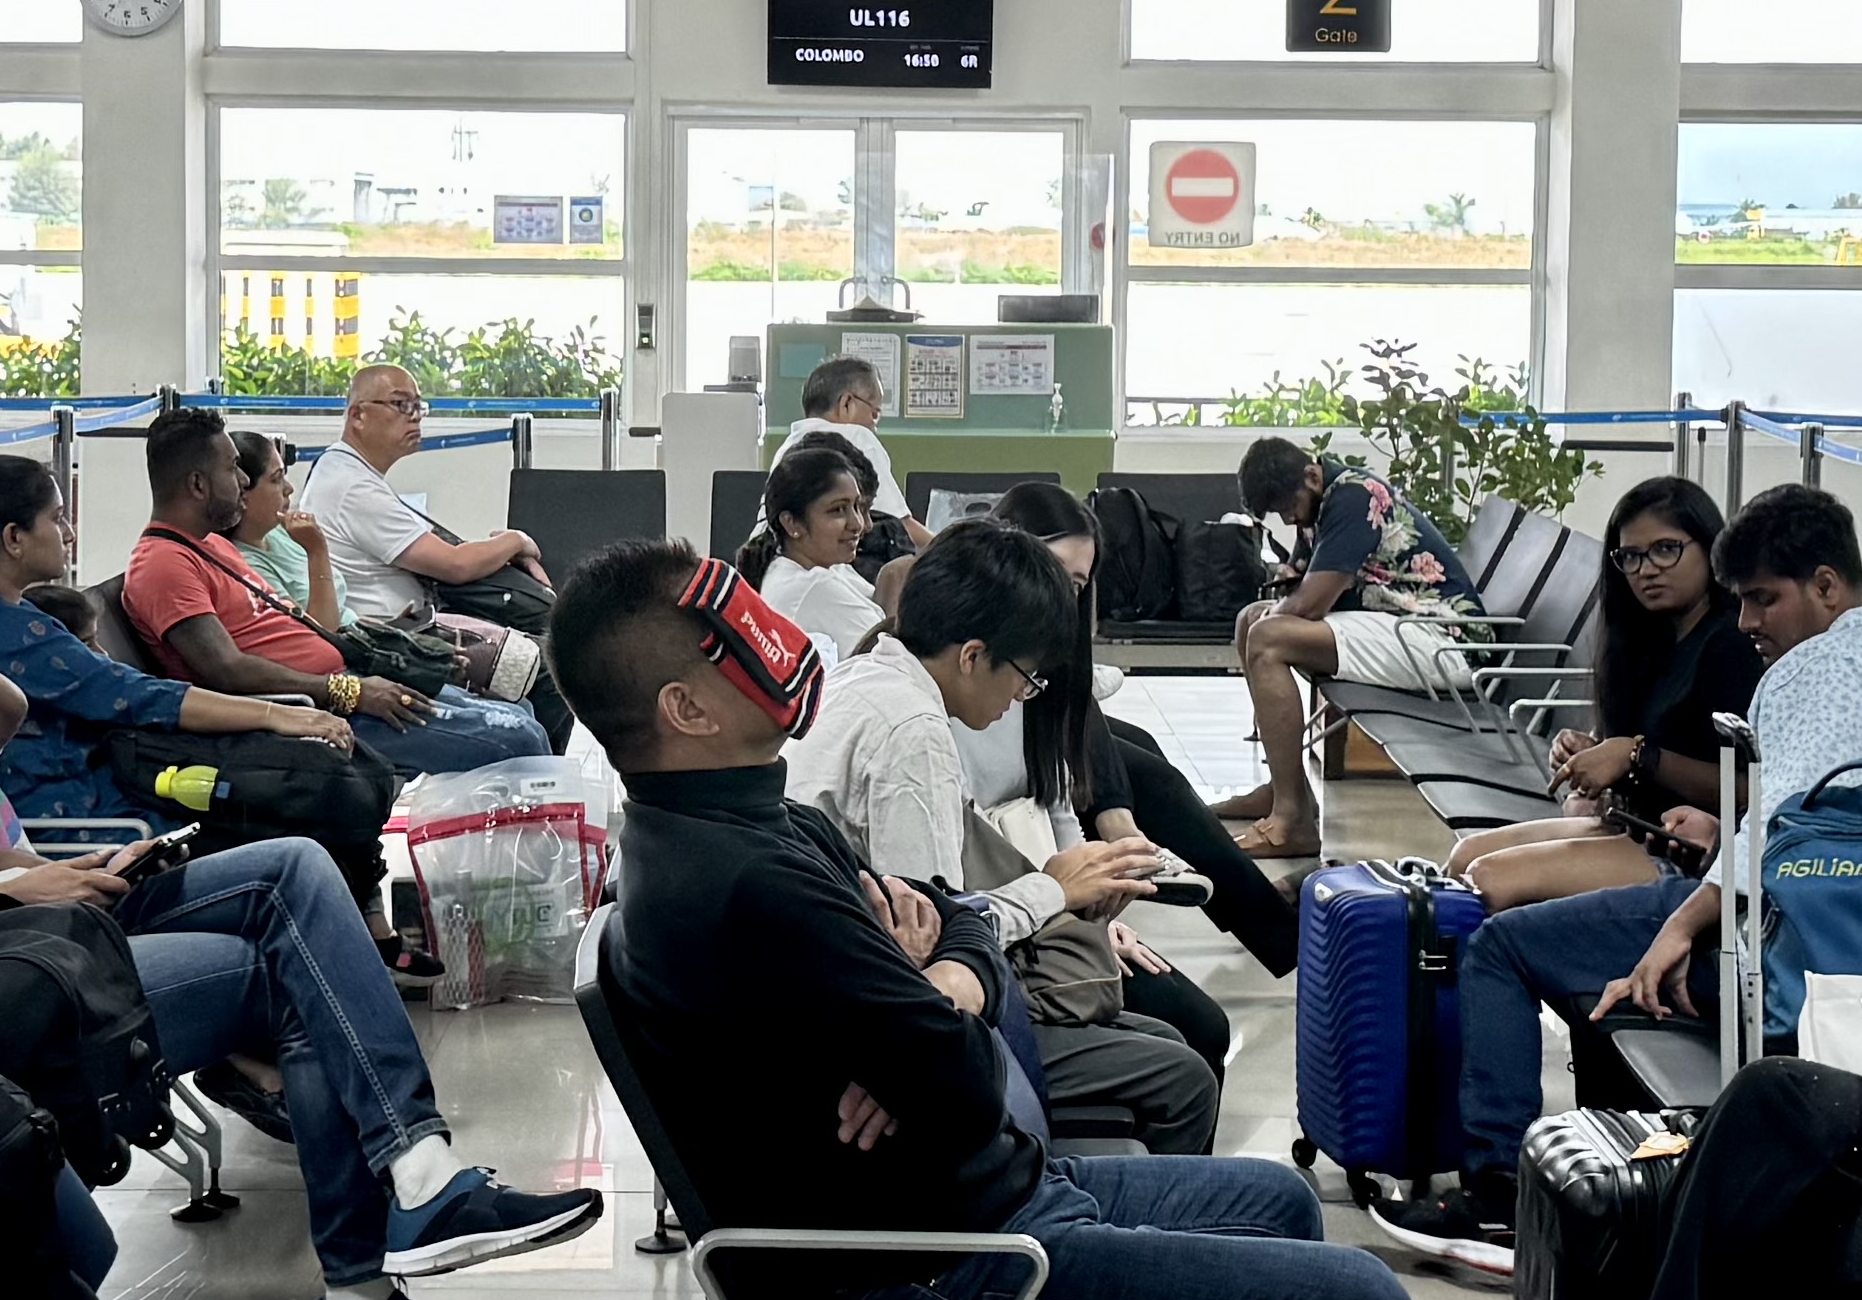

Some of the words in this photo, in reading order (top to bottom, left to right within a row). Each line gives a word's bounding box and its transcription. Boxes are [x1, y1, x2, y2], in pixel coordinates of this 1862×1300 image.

[849, 9, 910, 27] UL116
[1315, 27, 1358, 43] Gate
[795, 47, 865, 62] COLOMBO
[960, 54, 978, 68] 6R
